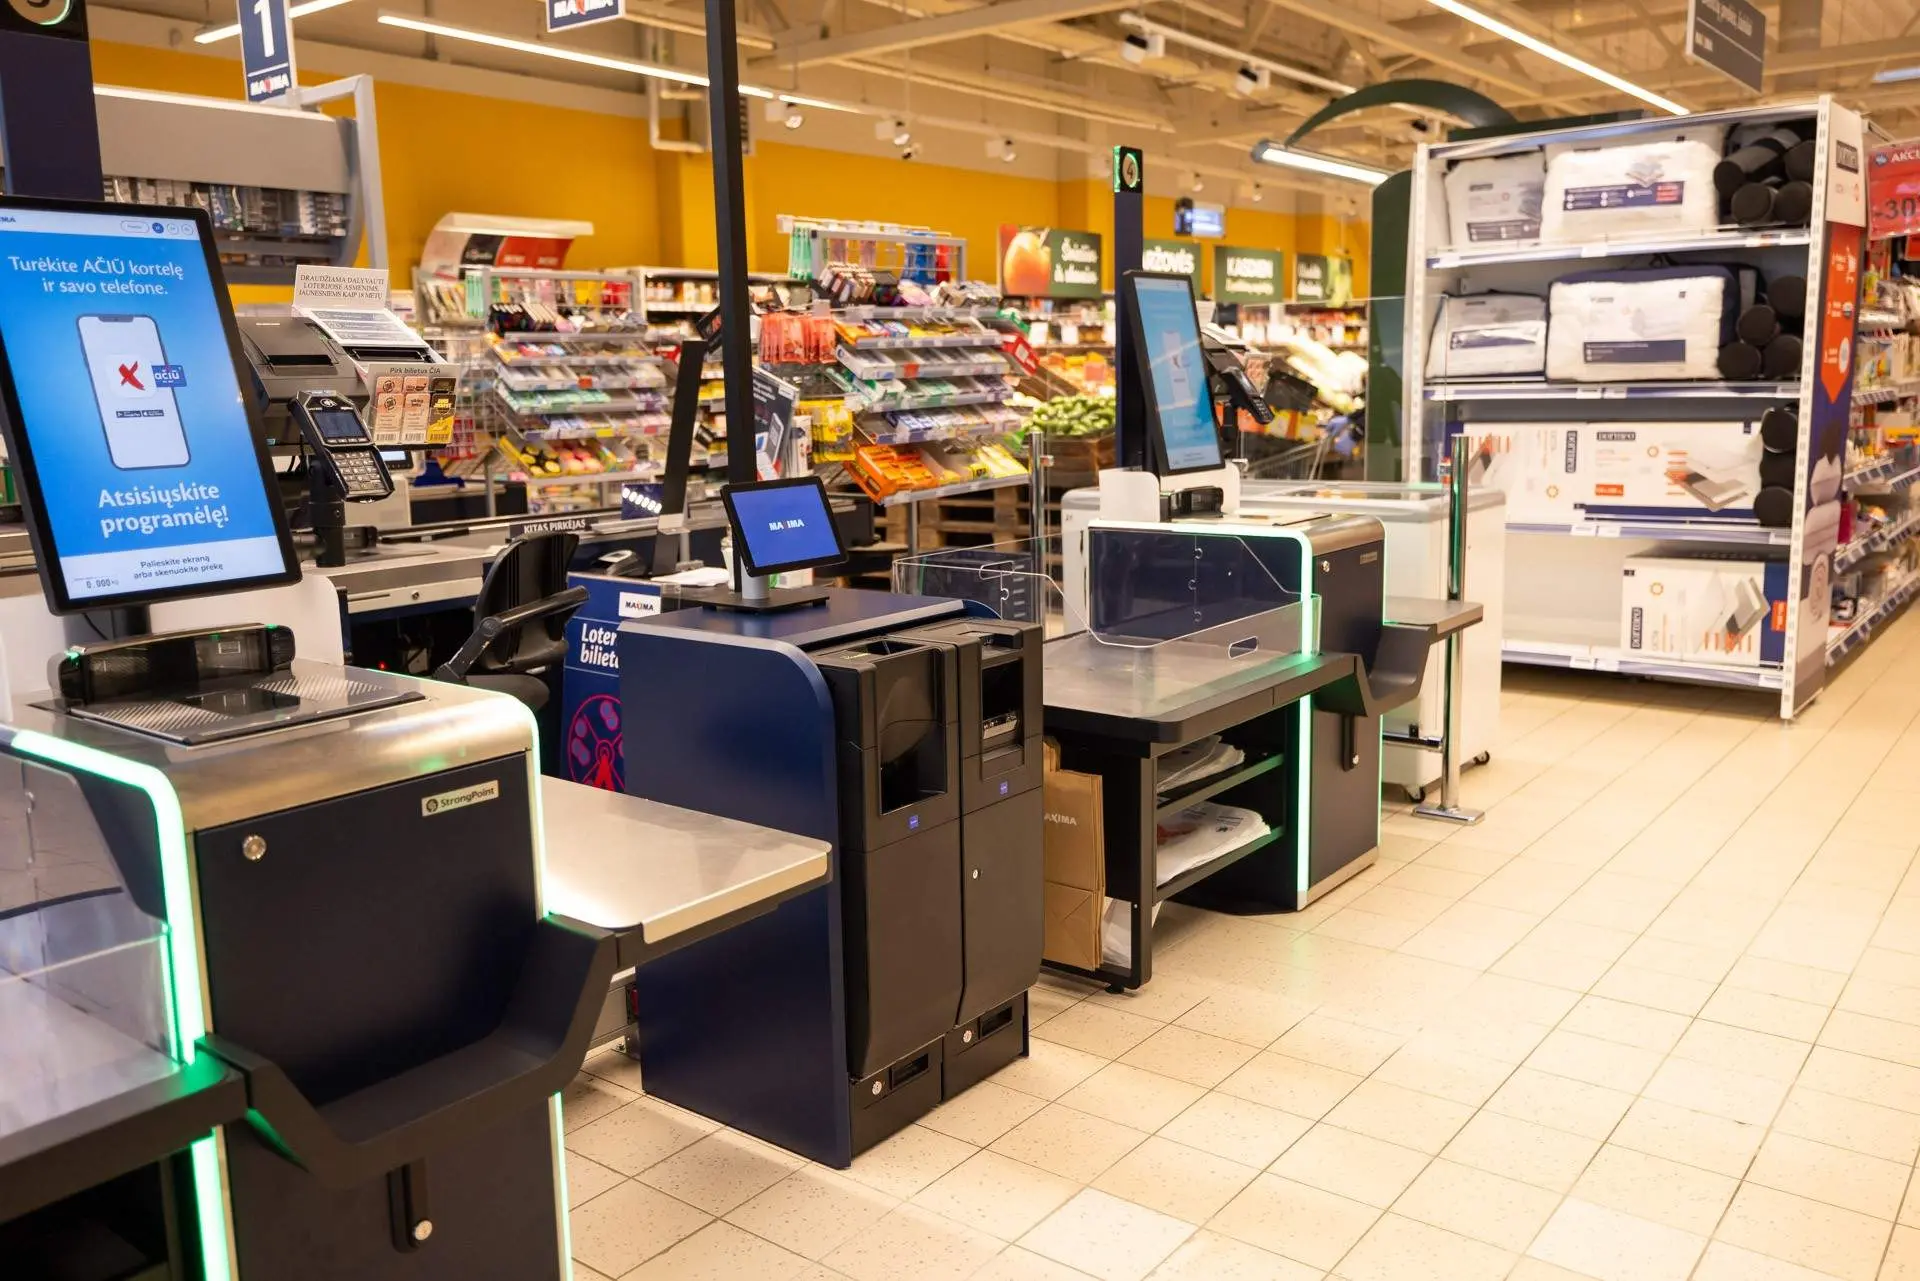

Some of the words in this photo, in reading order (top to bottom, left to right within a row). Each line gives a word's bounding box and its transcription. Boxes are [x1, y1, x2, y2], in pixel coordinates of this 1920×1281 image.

[254, 0, 275, 57] 1
[1874, 194, 1920, 220] -30
[8, 256, 78, 273] Turėkite
[83, 256, 126, 275] AČIŪ
[129, 259, 184, 281] kortelę
[42, 277, 55, 293] ir
[60, 281, 97, 294] savo
[100, 278, 169, 295] telefone.
[99, 480, 220, 509] Atsisiųskite
[100, 503, 230, 539] programėlę!
[524, 524, 549, 533] KITAS
[549, 519, 586, 531] PIRKĖJAS
[768, 518, 805, 531] MAXIMA
[140, 558, 181, 568] Palieskite
[182, 555, 211, 565] ekraną
[133, 571, 153, 580] arba
[155, 566, 199, 577] skenuokite
[201, 563, 224, 574] prekę
[625, 601, 654, 611] MAXIMA
[440, 787, 494, 807] StrongPoint
